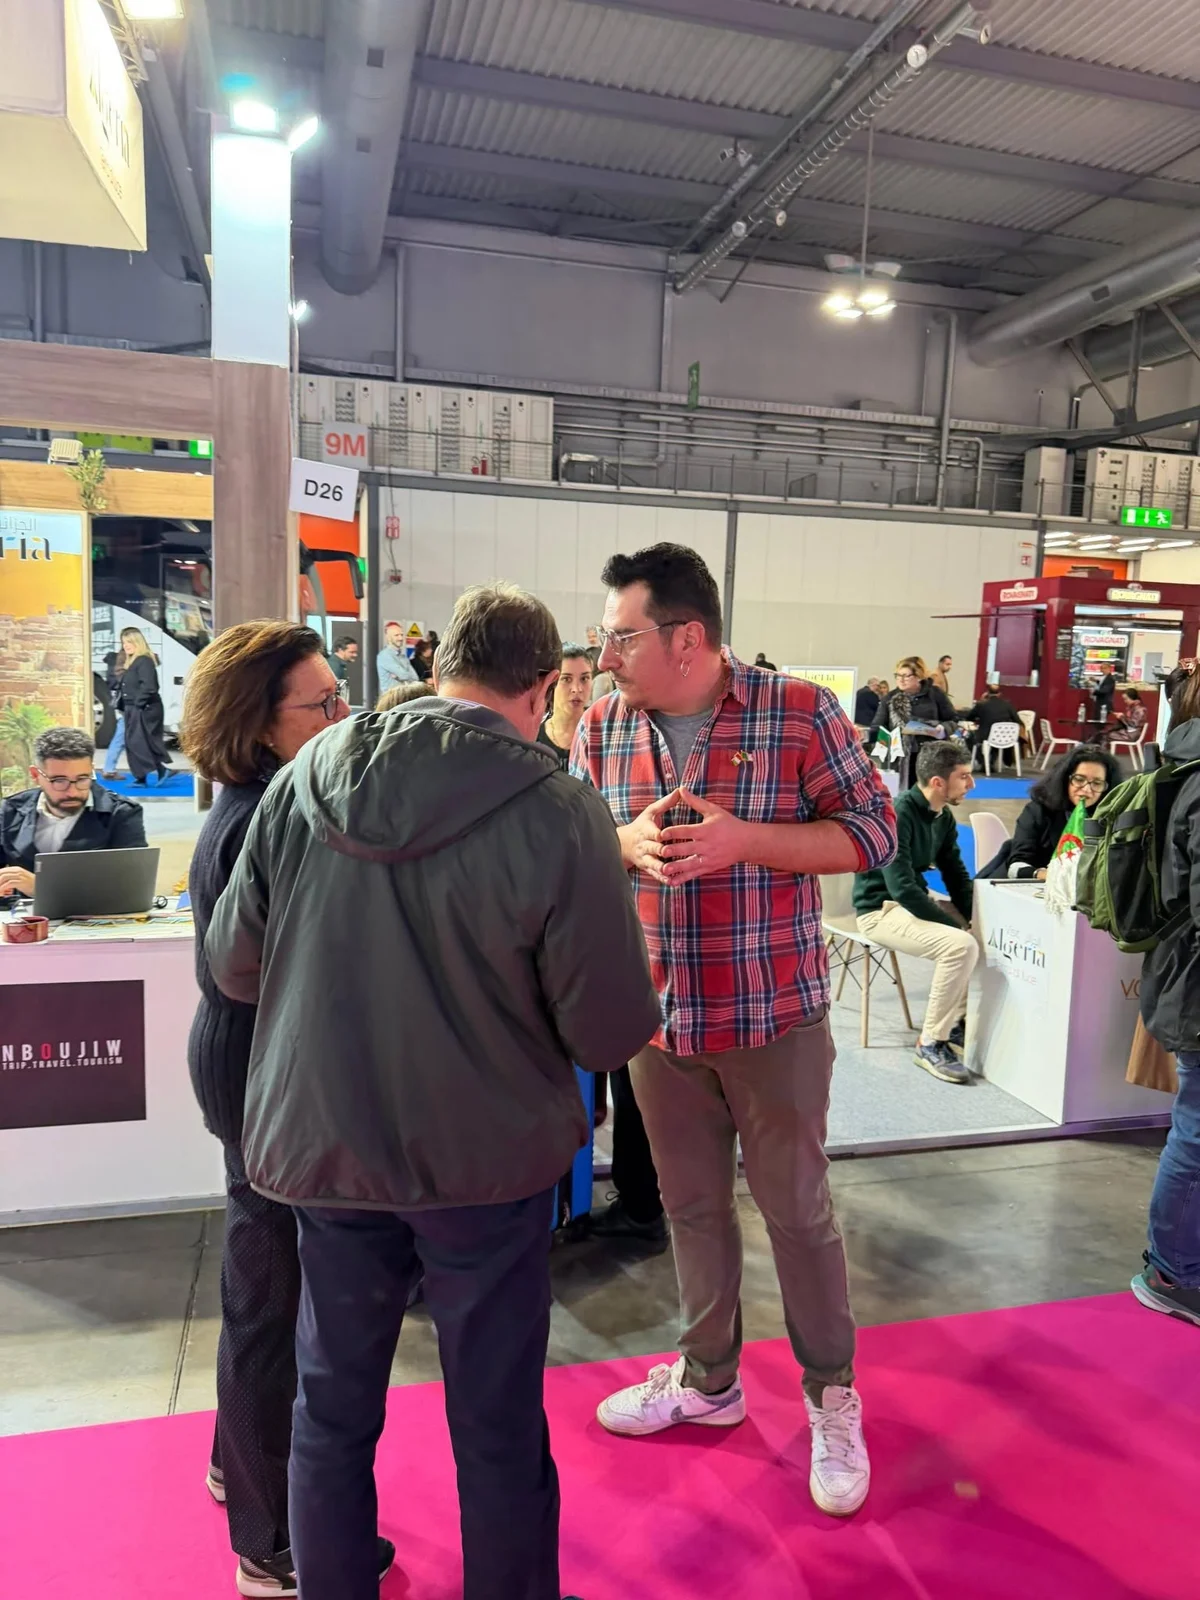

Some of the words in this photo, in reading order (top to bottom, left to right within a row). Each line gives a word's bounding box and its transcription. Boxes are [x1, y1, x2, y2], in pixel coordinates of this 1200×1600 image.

[324, 432, 366, 457] 9M
[304, 478, 344, 502] D26
[987, 927, 1046, 968] Algeria
